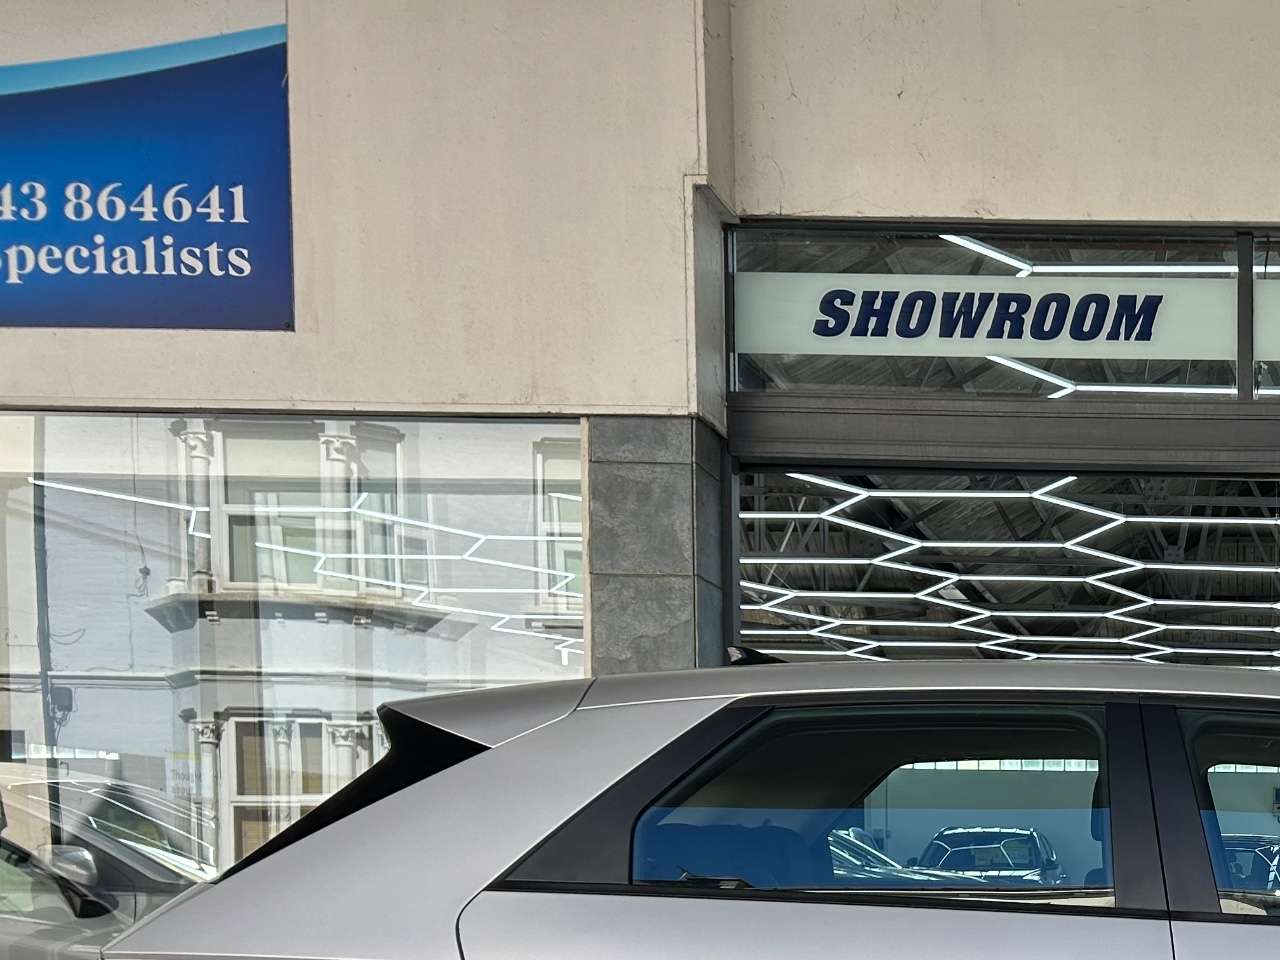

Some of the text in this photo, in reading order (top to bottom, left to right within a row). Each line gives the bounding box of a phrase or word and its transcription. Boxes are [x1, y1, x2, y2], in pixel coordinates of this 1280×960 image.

[0, 182, 249, 223] 43 864641
[0, 234, 252, 284] pecialists
[813, 288, 1164, 342] SHOWROOM
